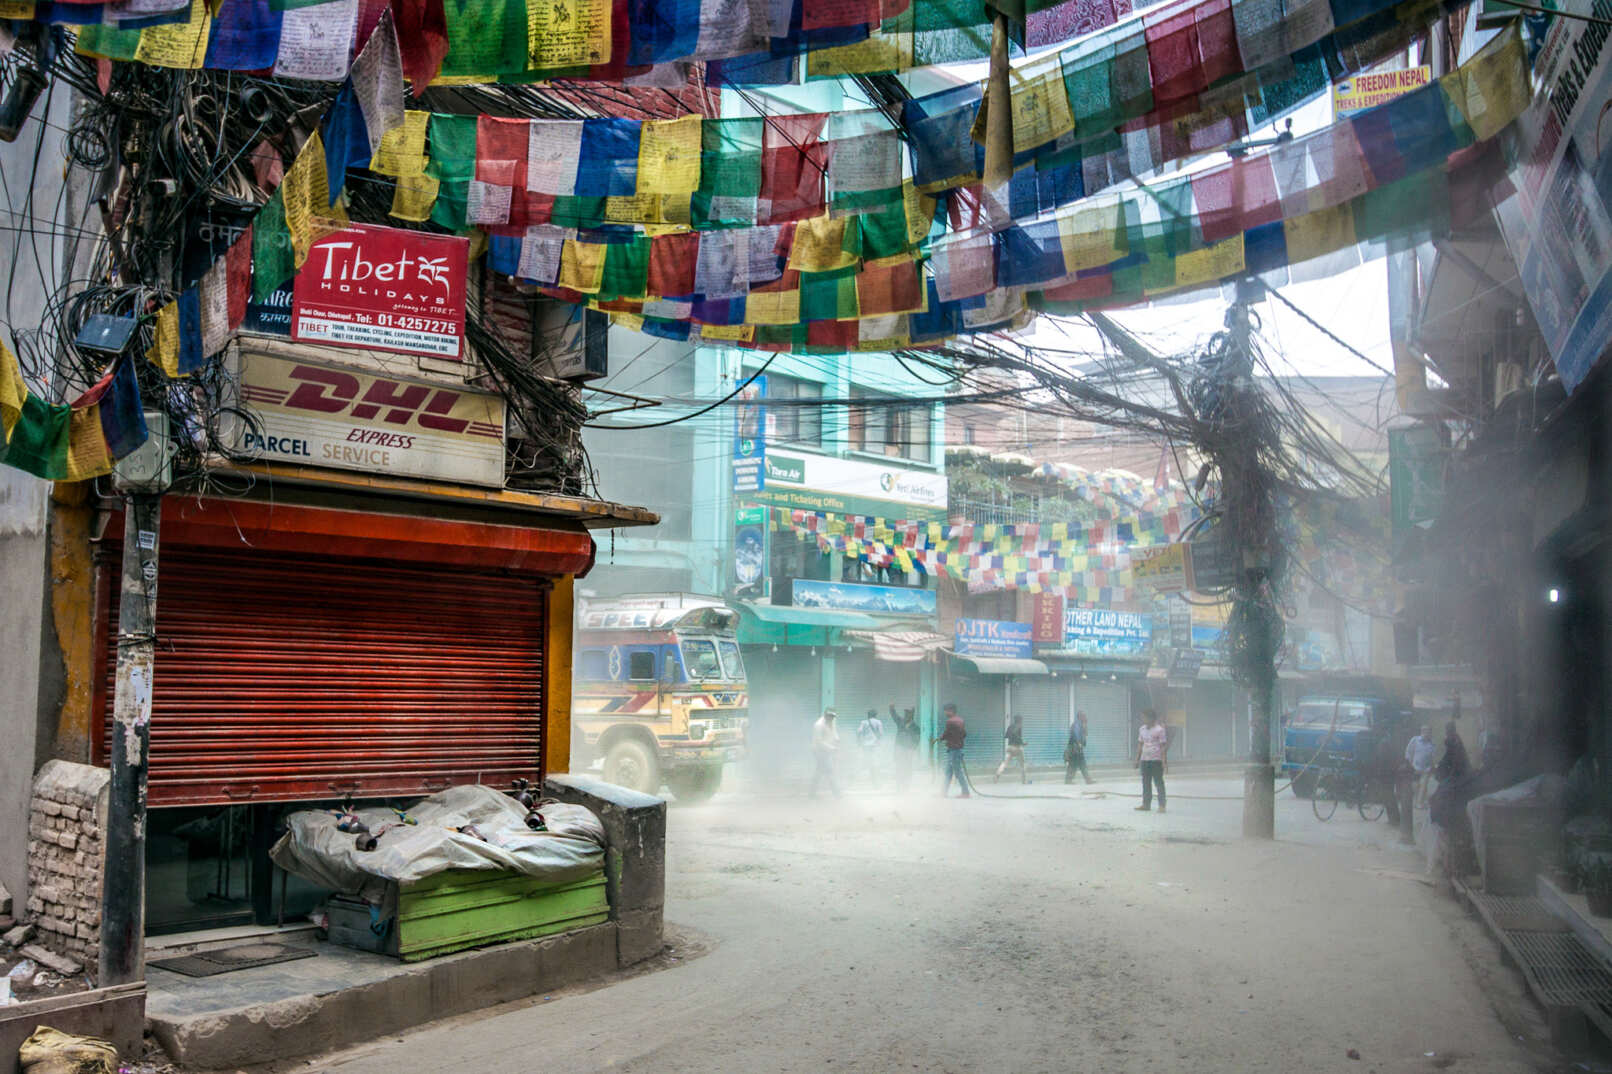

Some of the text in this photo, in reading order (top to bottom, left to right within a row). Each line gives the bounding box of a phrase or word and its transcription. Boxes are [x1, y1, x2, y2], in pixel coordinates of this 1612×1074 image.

[1356, 68, 1427, 93] FREEDOM NEPAL
[313, 242, 415, 281] Tibet
[320, 281, 445, 304] HOLIDAYS
[300, 322, 328, 333] TIBET
[355, 313, 372, 324] Tel:
[377, 313, 456, 334] 01-4257275
[286, 365, 470, 433] DHL
[244, 433, 390, 467] PARCEL SERVICE
[346, 428, 417, 450] EXPRESS
[1094, 611, 1117, 627] LAND
[1118, 613, 1143, 628] NEPAL
